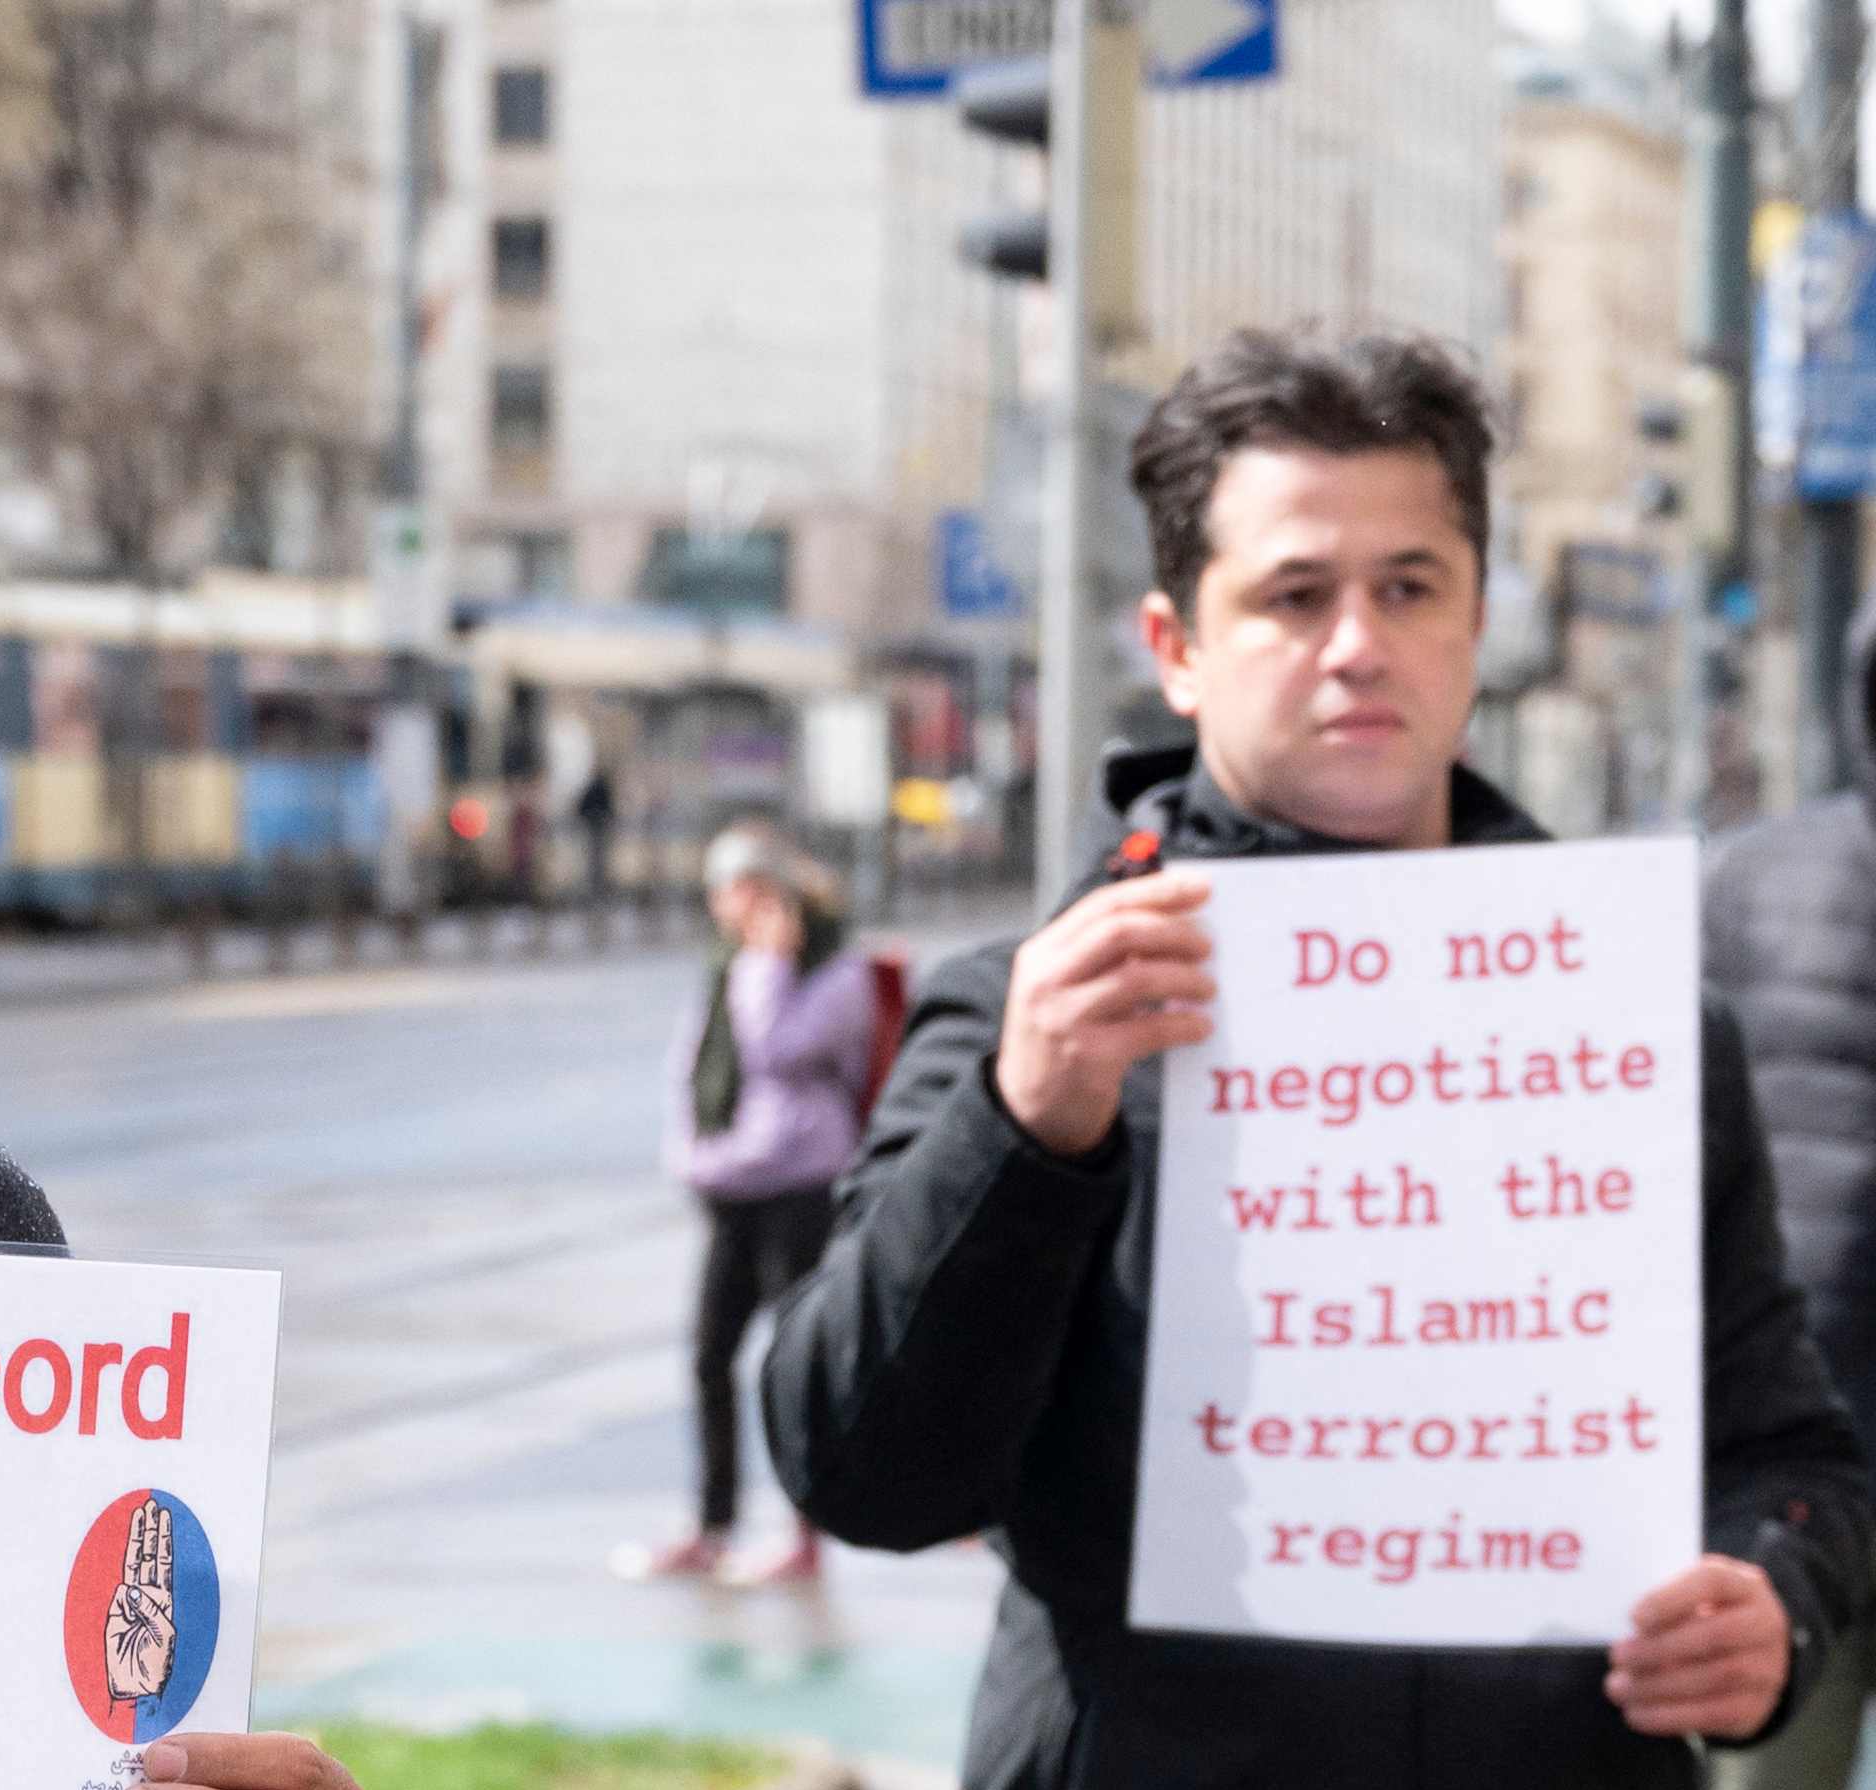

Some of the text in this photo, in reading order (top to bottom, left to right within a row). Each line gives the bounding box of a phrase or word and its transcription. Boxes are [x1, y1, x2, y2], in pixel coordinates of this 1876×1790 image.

[1294, 918, 1581, 988] Do not
[1208, 1038, 1656, 1126] negotiate
[1227, 1156, 1634, 1232] with the
[1260, 1279, 1610, 1348] Islamic
[1194, 1399, 1658, 1460] terrorist
[1266, 1512, 1582, 1584] regime
